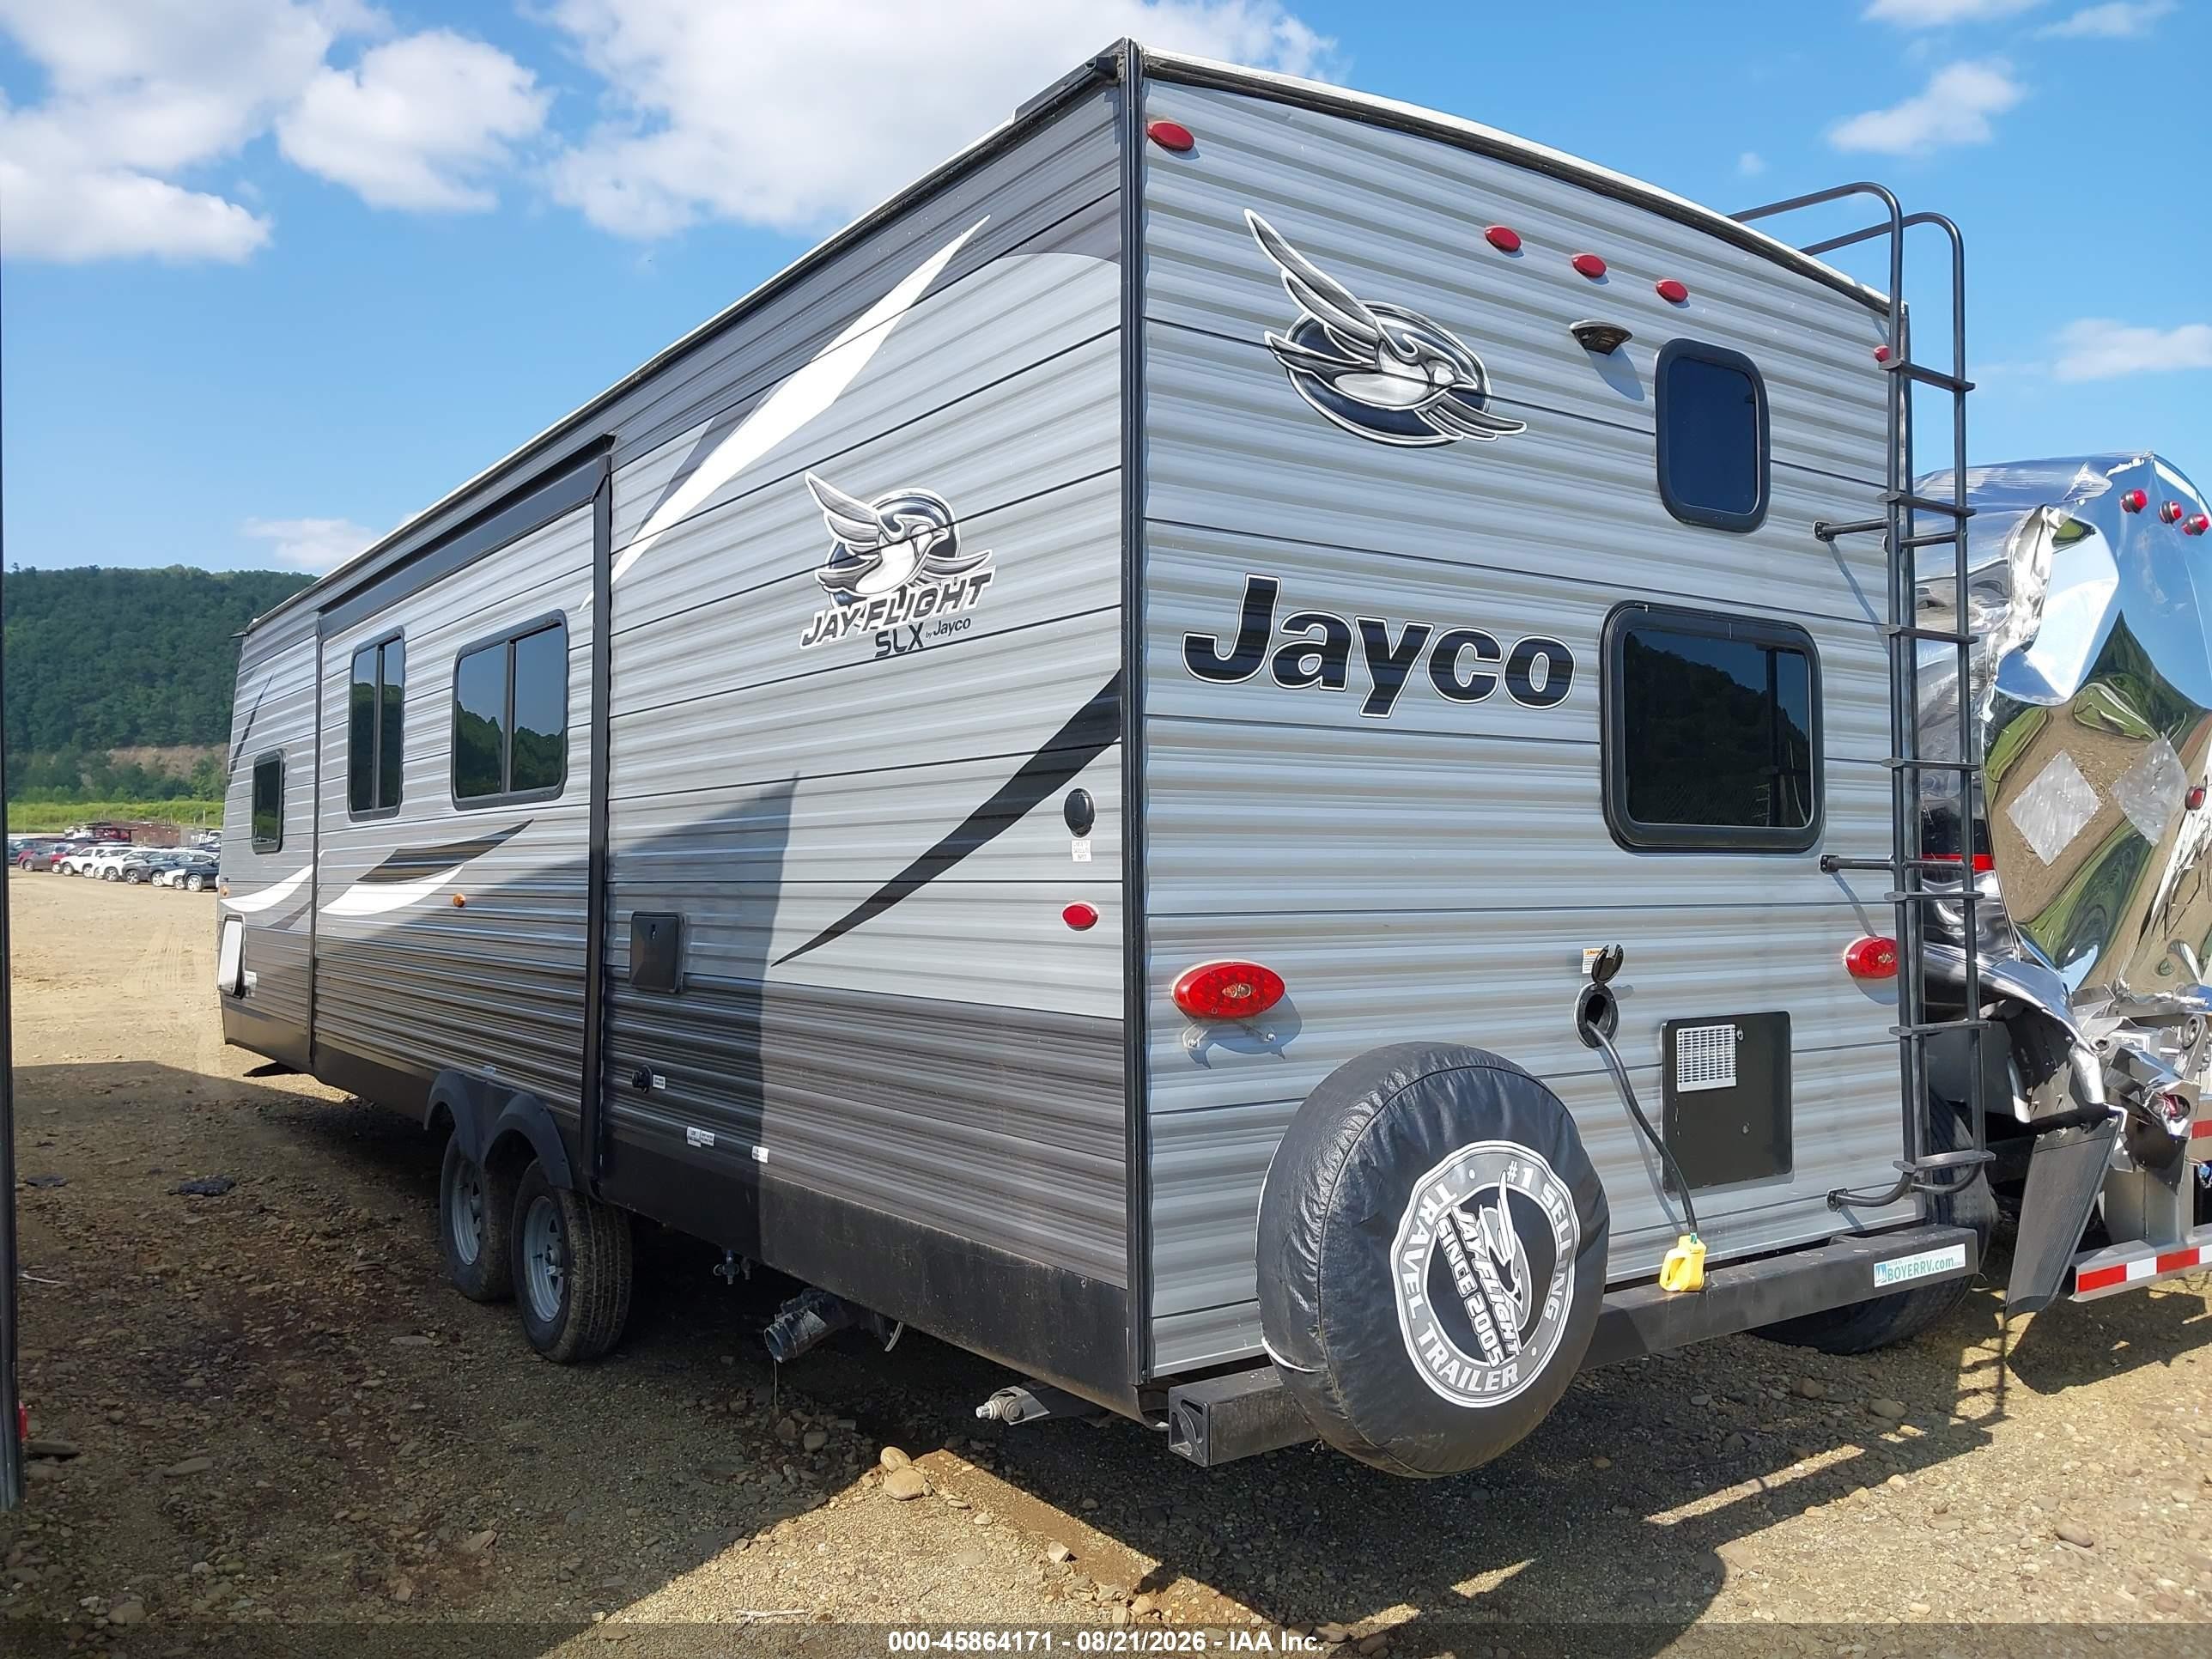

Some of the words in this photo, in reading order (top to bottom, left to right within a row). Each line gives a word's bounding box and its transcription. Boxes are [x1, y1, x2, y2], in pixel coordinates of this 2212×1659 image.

[800, 606, 860, 647] JAY
[860, 569, 994, 632] FLIGHT
[874, 622, 925, 658] SLX
[933, 617, 972, 637] Jayco
[1182, 573, 1577, 719] Jayco
[1401, 1183, 1458, 1320] TRAVEL
[1435, 1217, 1478, 1297] SINCE
[1464, 1292, 1504, 1368] 2005
[1451, 1205, 1488, 1259] JAY
[1474, 1258, 1522, 1357] FLIGHT
[1506, 1160, 1536, 1190] #1
[1540, 1183, 1572, 1322] SELLING
[1887, 1256, 1954, 1282] BOYERRV.com
[1418, 1322, 1519, 1392] TRAILER
